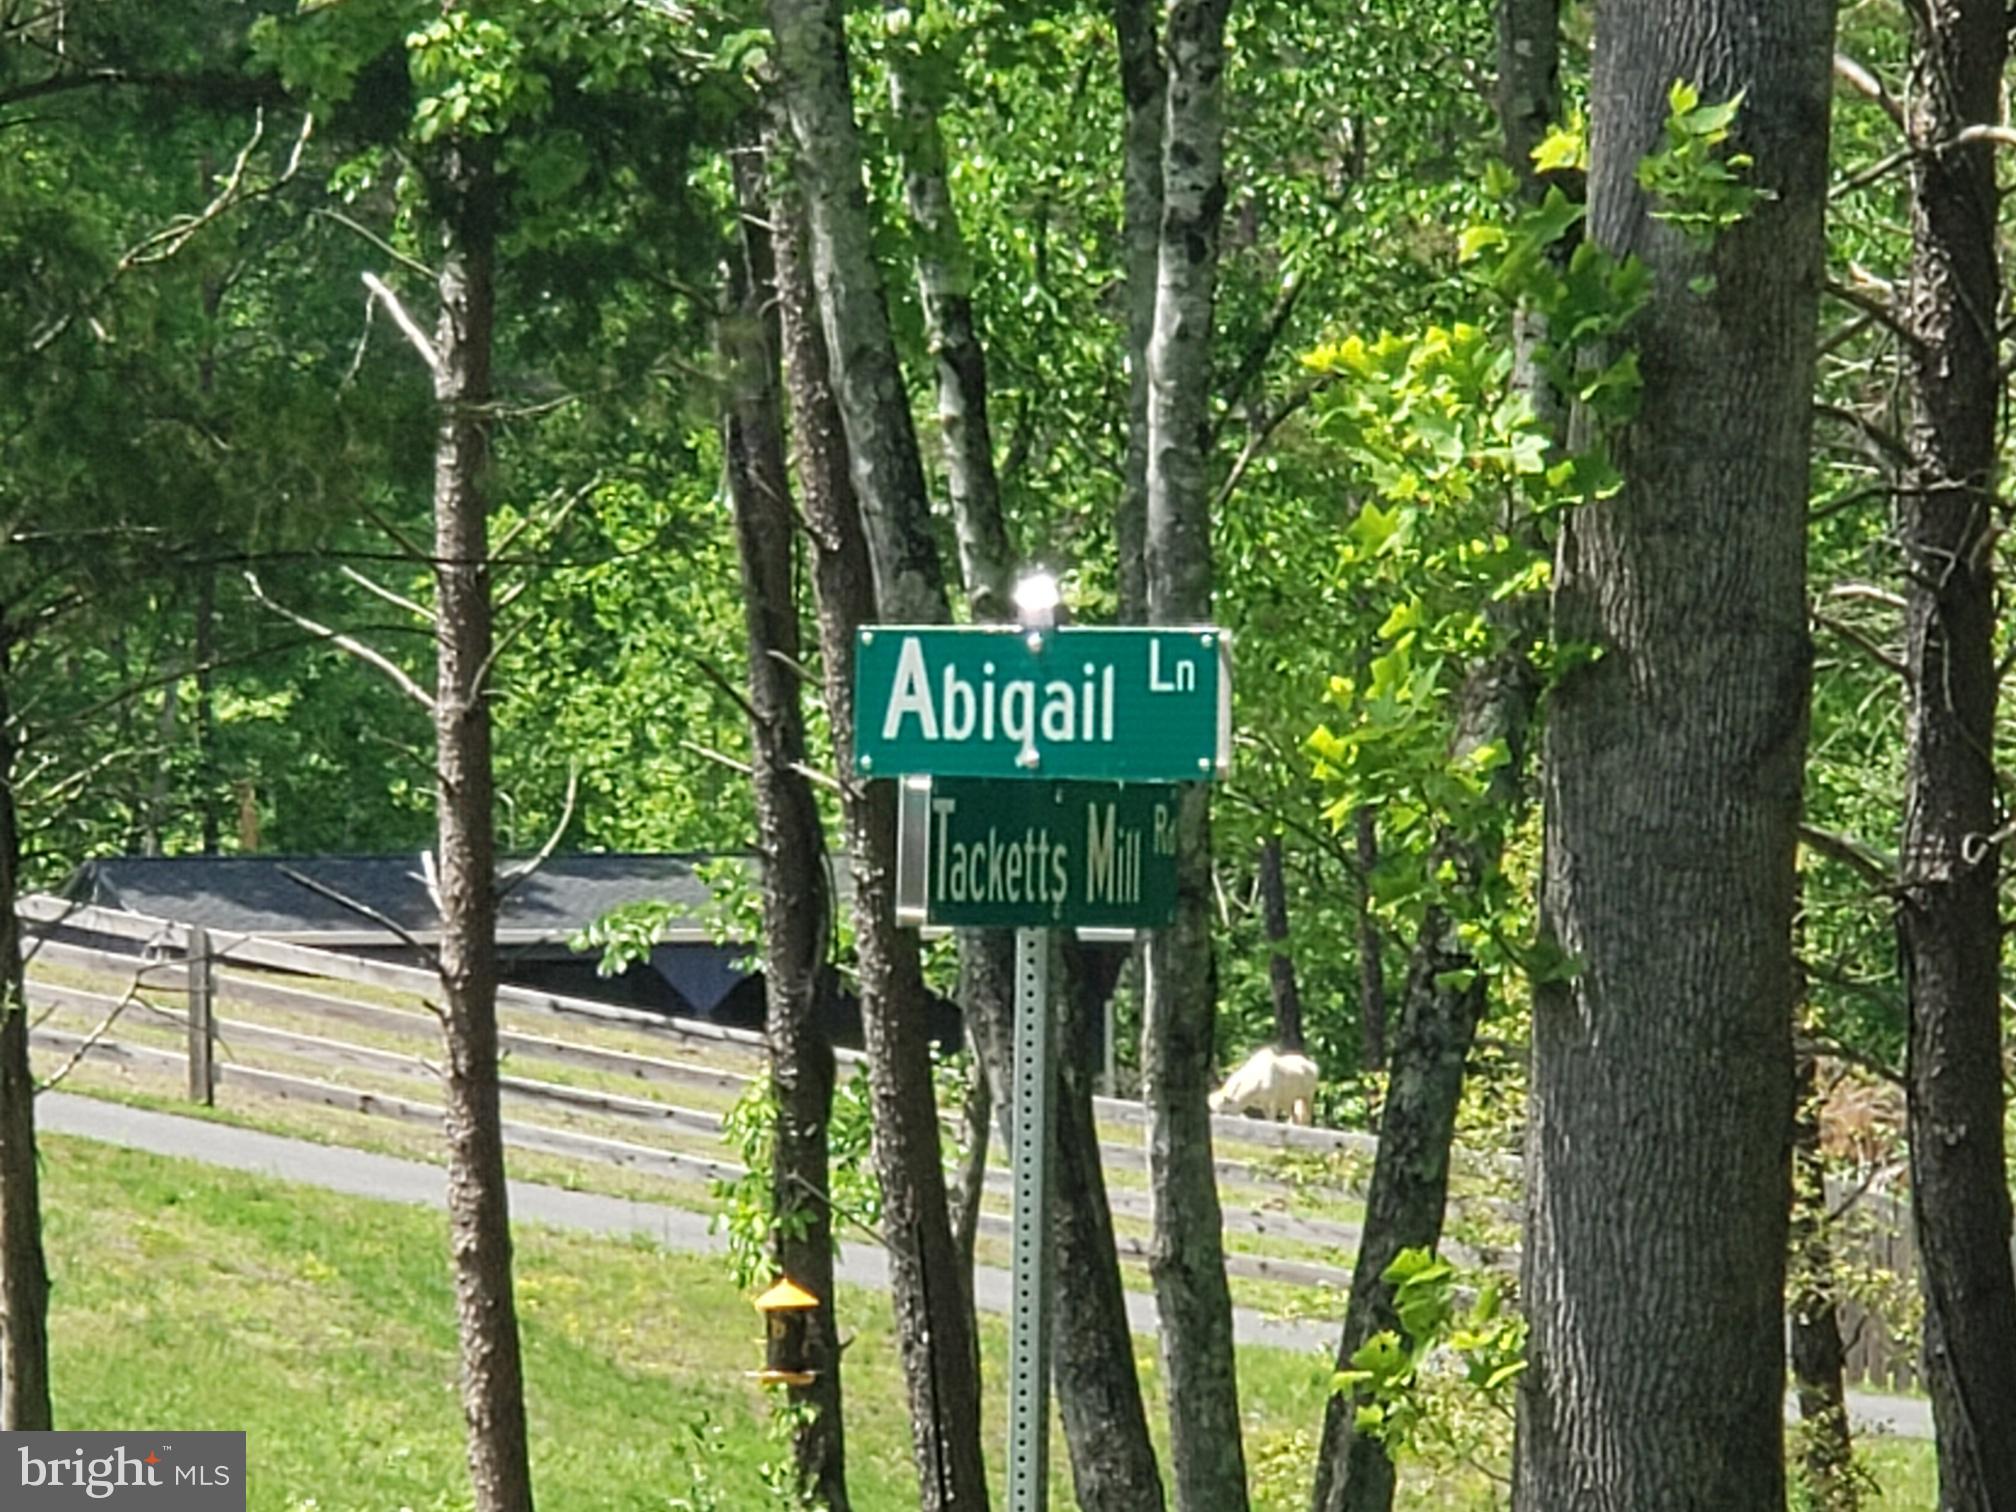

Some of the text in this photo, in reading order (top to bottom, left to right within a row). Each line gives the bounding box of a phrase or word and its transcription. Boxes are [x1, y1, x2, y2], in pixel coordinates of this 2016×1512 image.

[882, 636, 1195, 767] Abigail Ln
[933, 798, 1068, 904] Tacketts
[1086, 802, 1141, 904] Mill
